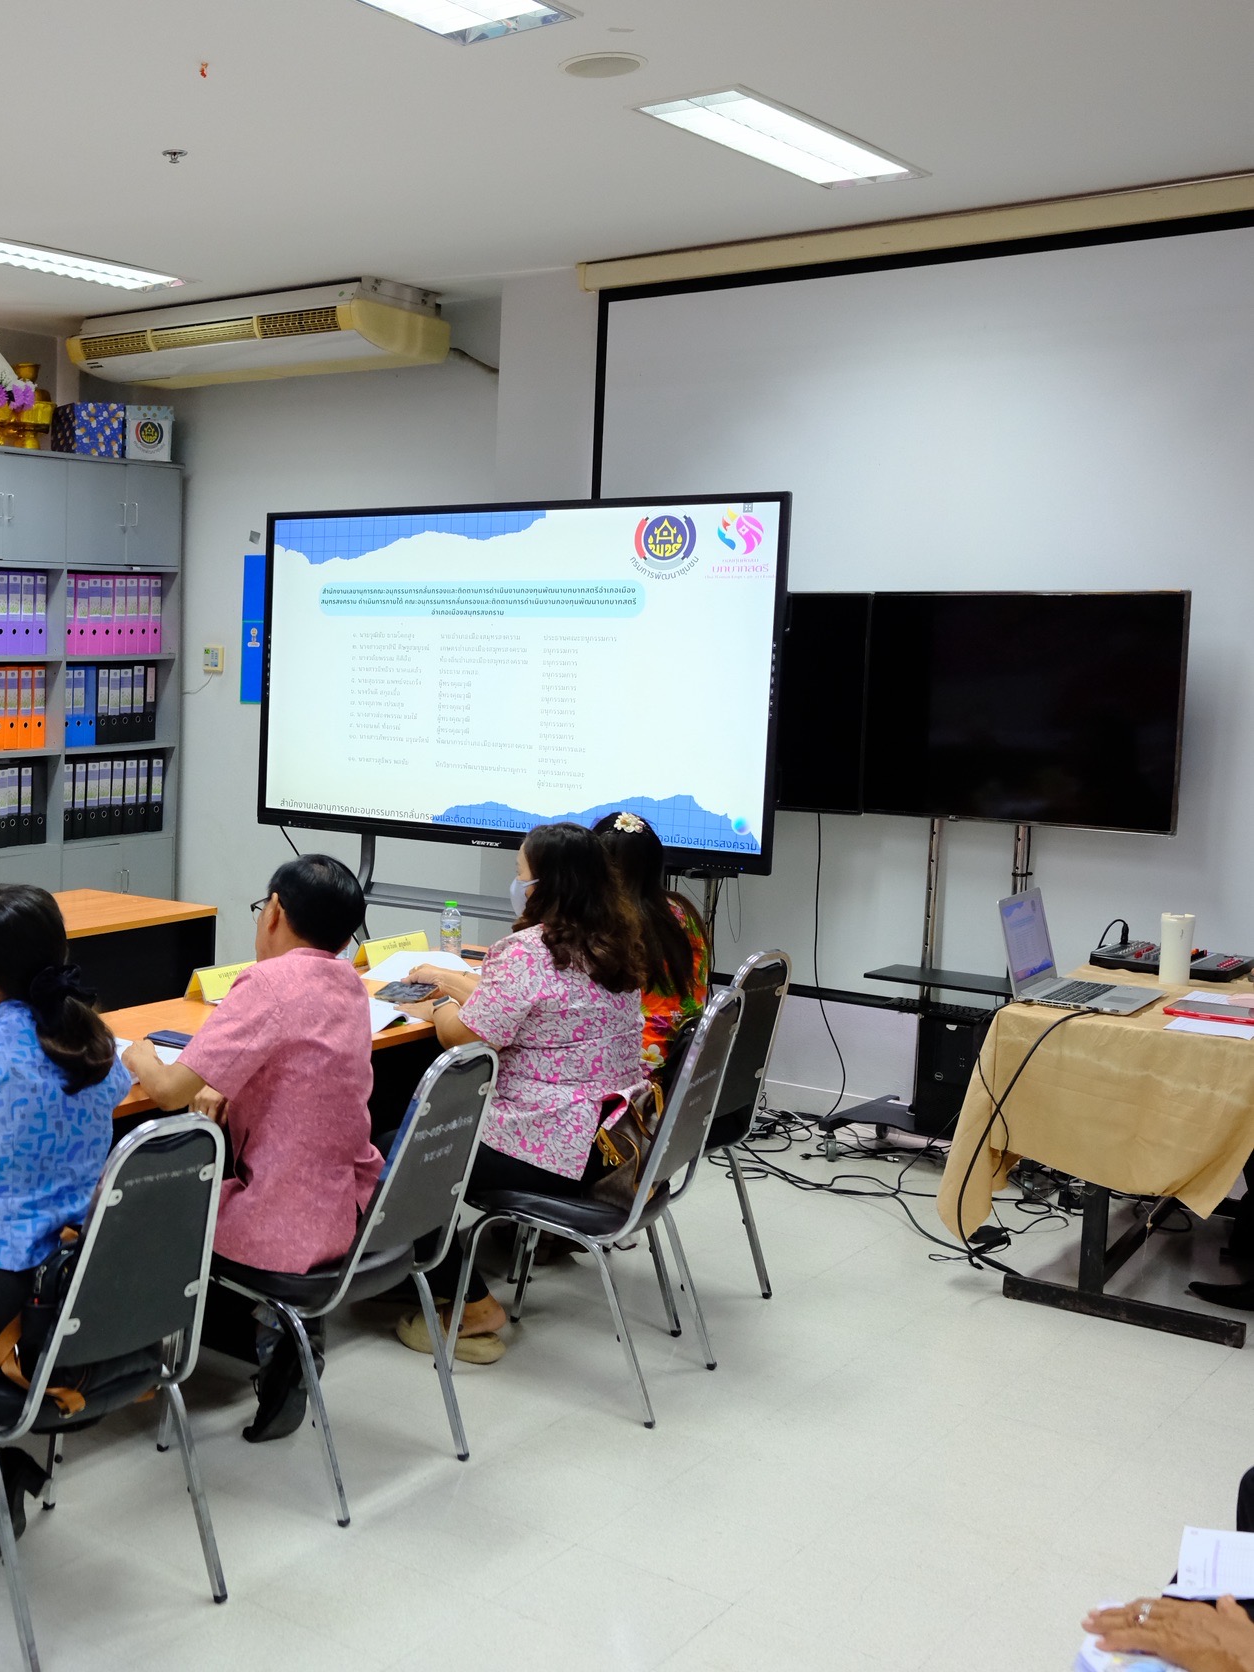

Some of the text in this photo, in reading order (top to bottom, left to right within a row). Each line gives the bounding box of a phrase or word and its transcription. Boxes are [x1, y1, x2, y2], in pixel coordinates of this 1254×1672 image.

[630, 556, 700, 580] กรมการพัฒนาชุมชน
[431, 609, 505, 618] อำเภอเมืองสมุทรสงคราม
